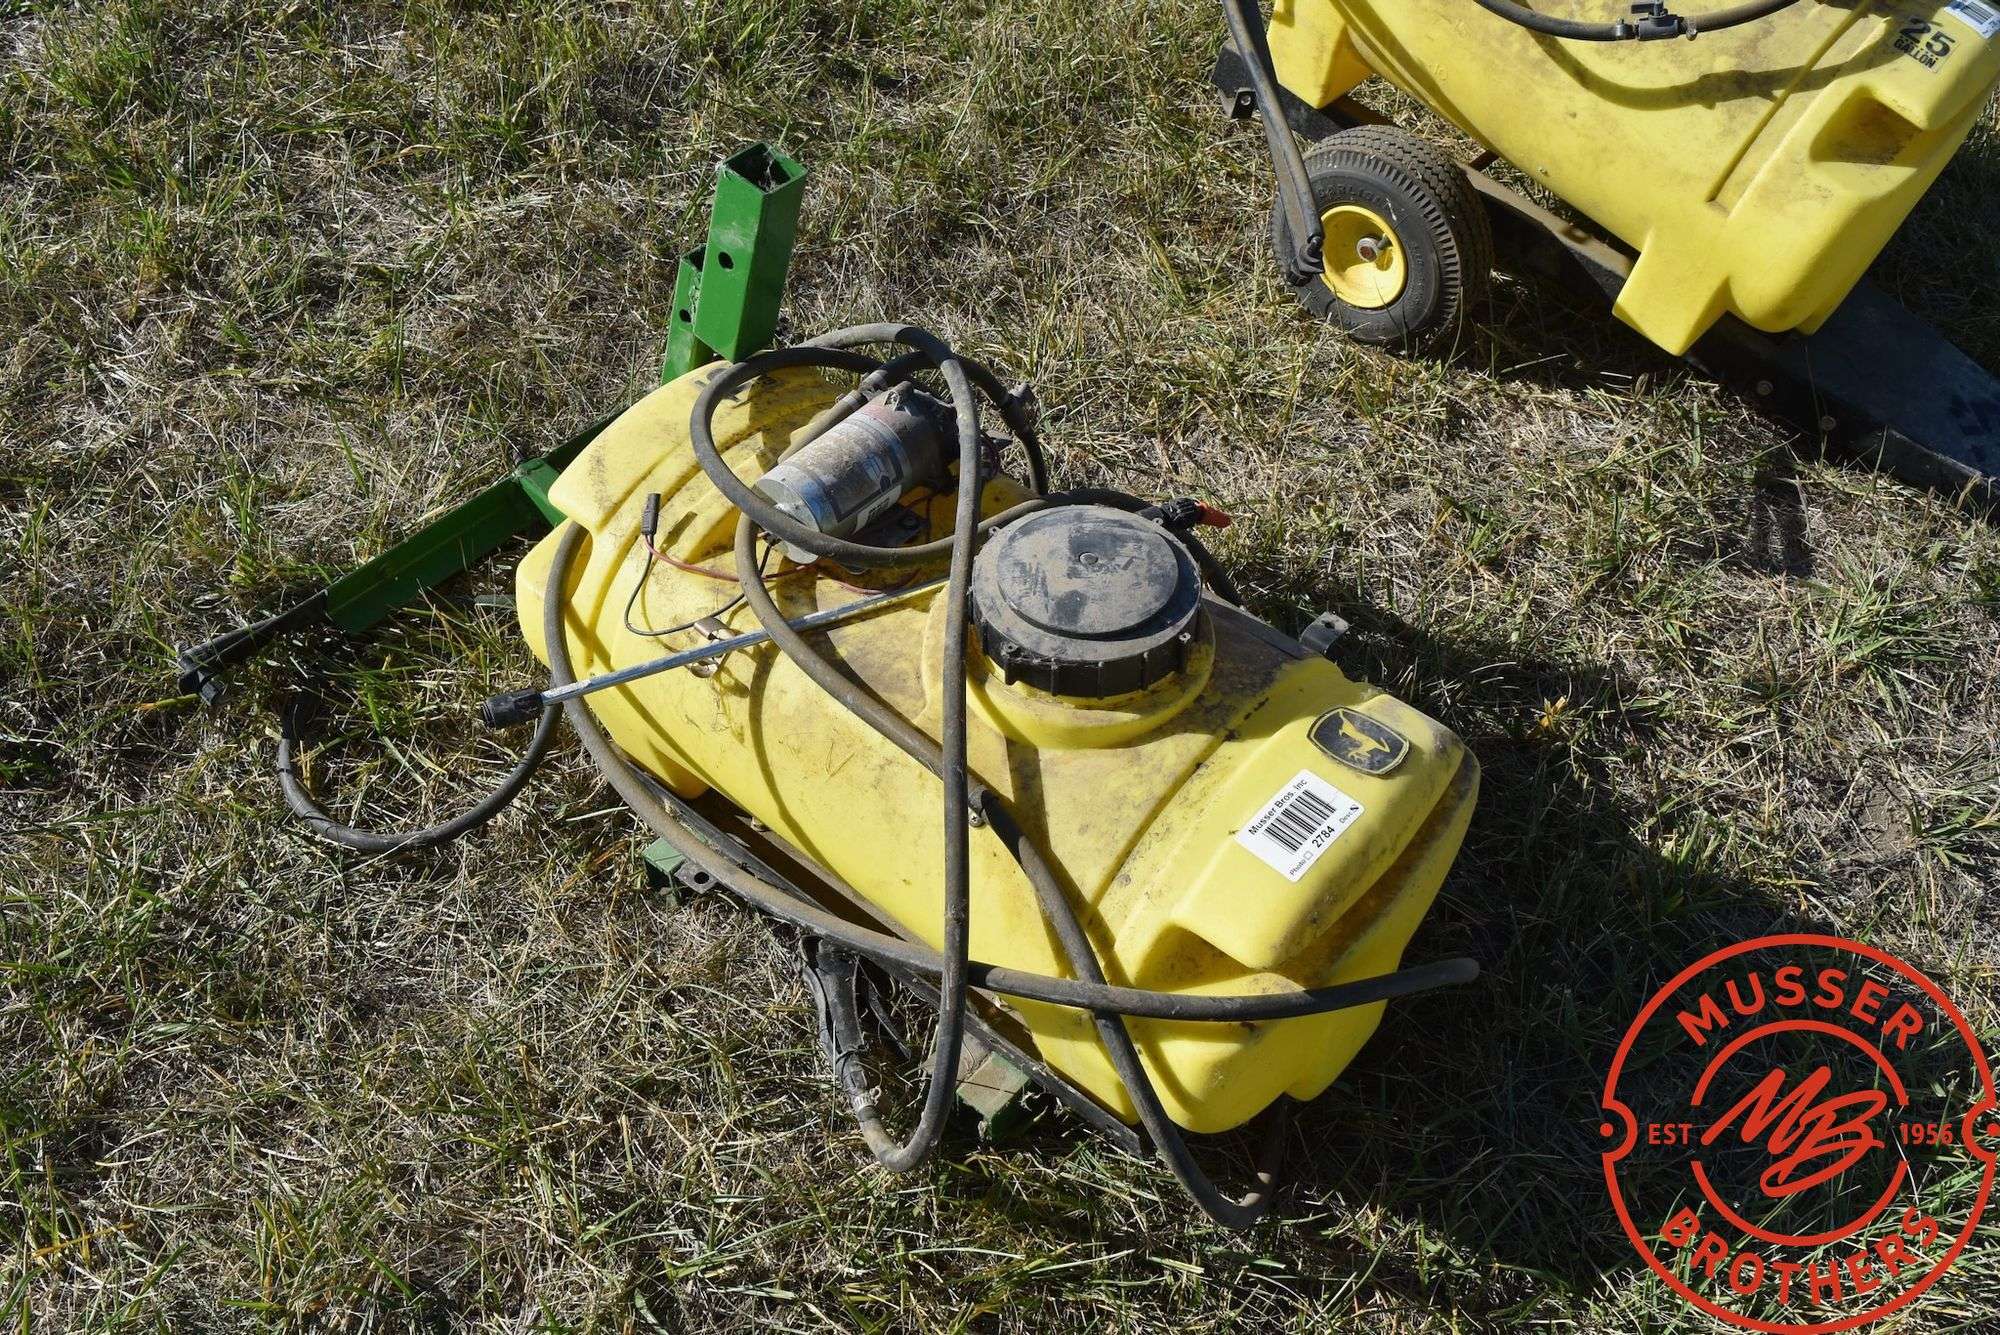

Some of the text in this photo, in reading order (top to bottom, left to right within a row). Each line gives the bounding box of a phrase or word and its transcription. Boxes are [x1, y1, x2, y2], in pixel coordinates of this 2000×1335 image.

[1893, 37, 1937, 69] GALLON
[1899, 17, 1956, 57] 25
[1248, 808, 1278, 836] Musser
[1274, 791, 1296, 809] Bros.
[1311, 825, 1336, 849] 2784
